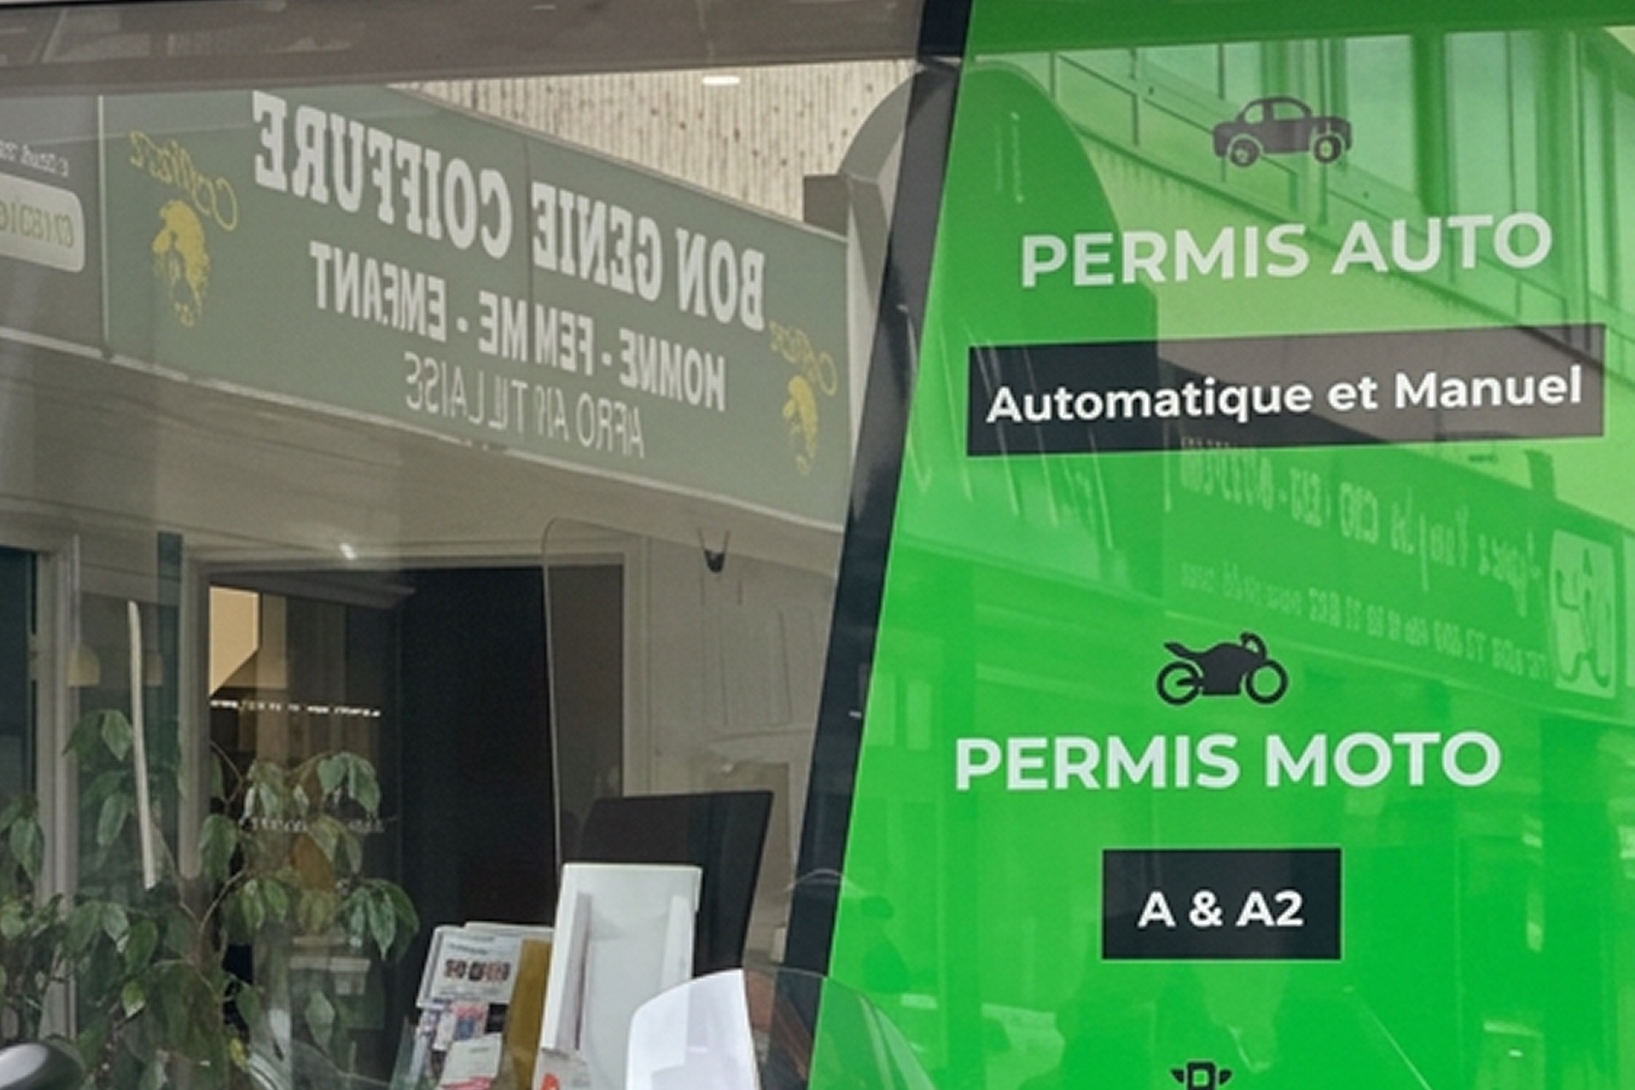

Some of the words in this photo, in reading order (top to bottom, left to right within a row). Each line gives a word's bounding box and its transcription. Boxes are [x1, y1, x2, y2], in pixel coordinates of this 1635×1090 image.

[1020, 222, 1308, 288] PERMIS
[1332, 211, 1553, 275] AUTO
[985, 377, 1313, 424] Automatique
[1327, 378, 1378, 411] et
[1395, 365, 1583, 409] Manuel
[956, 733, 1241, 791] PERMIS
[1266, 731, 1502, 788] MOTO
[1137, 891, 1176, 928] A
[1189, 891, 1224, 928] &
[1237, 890, 1305, 927] A2
